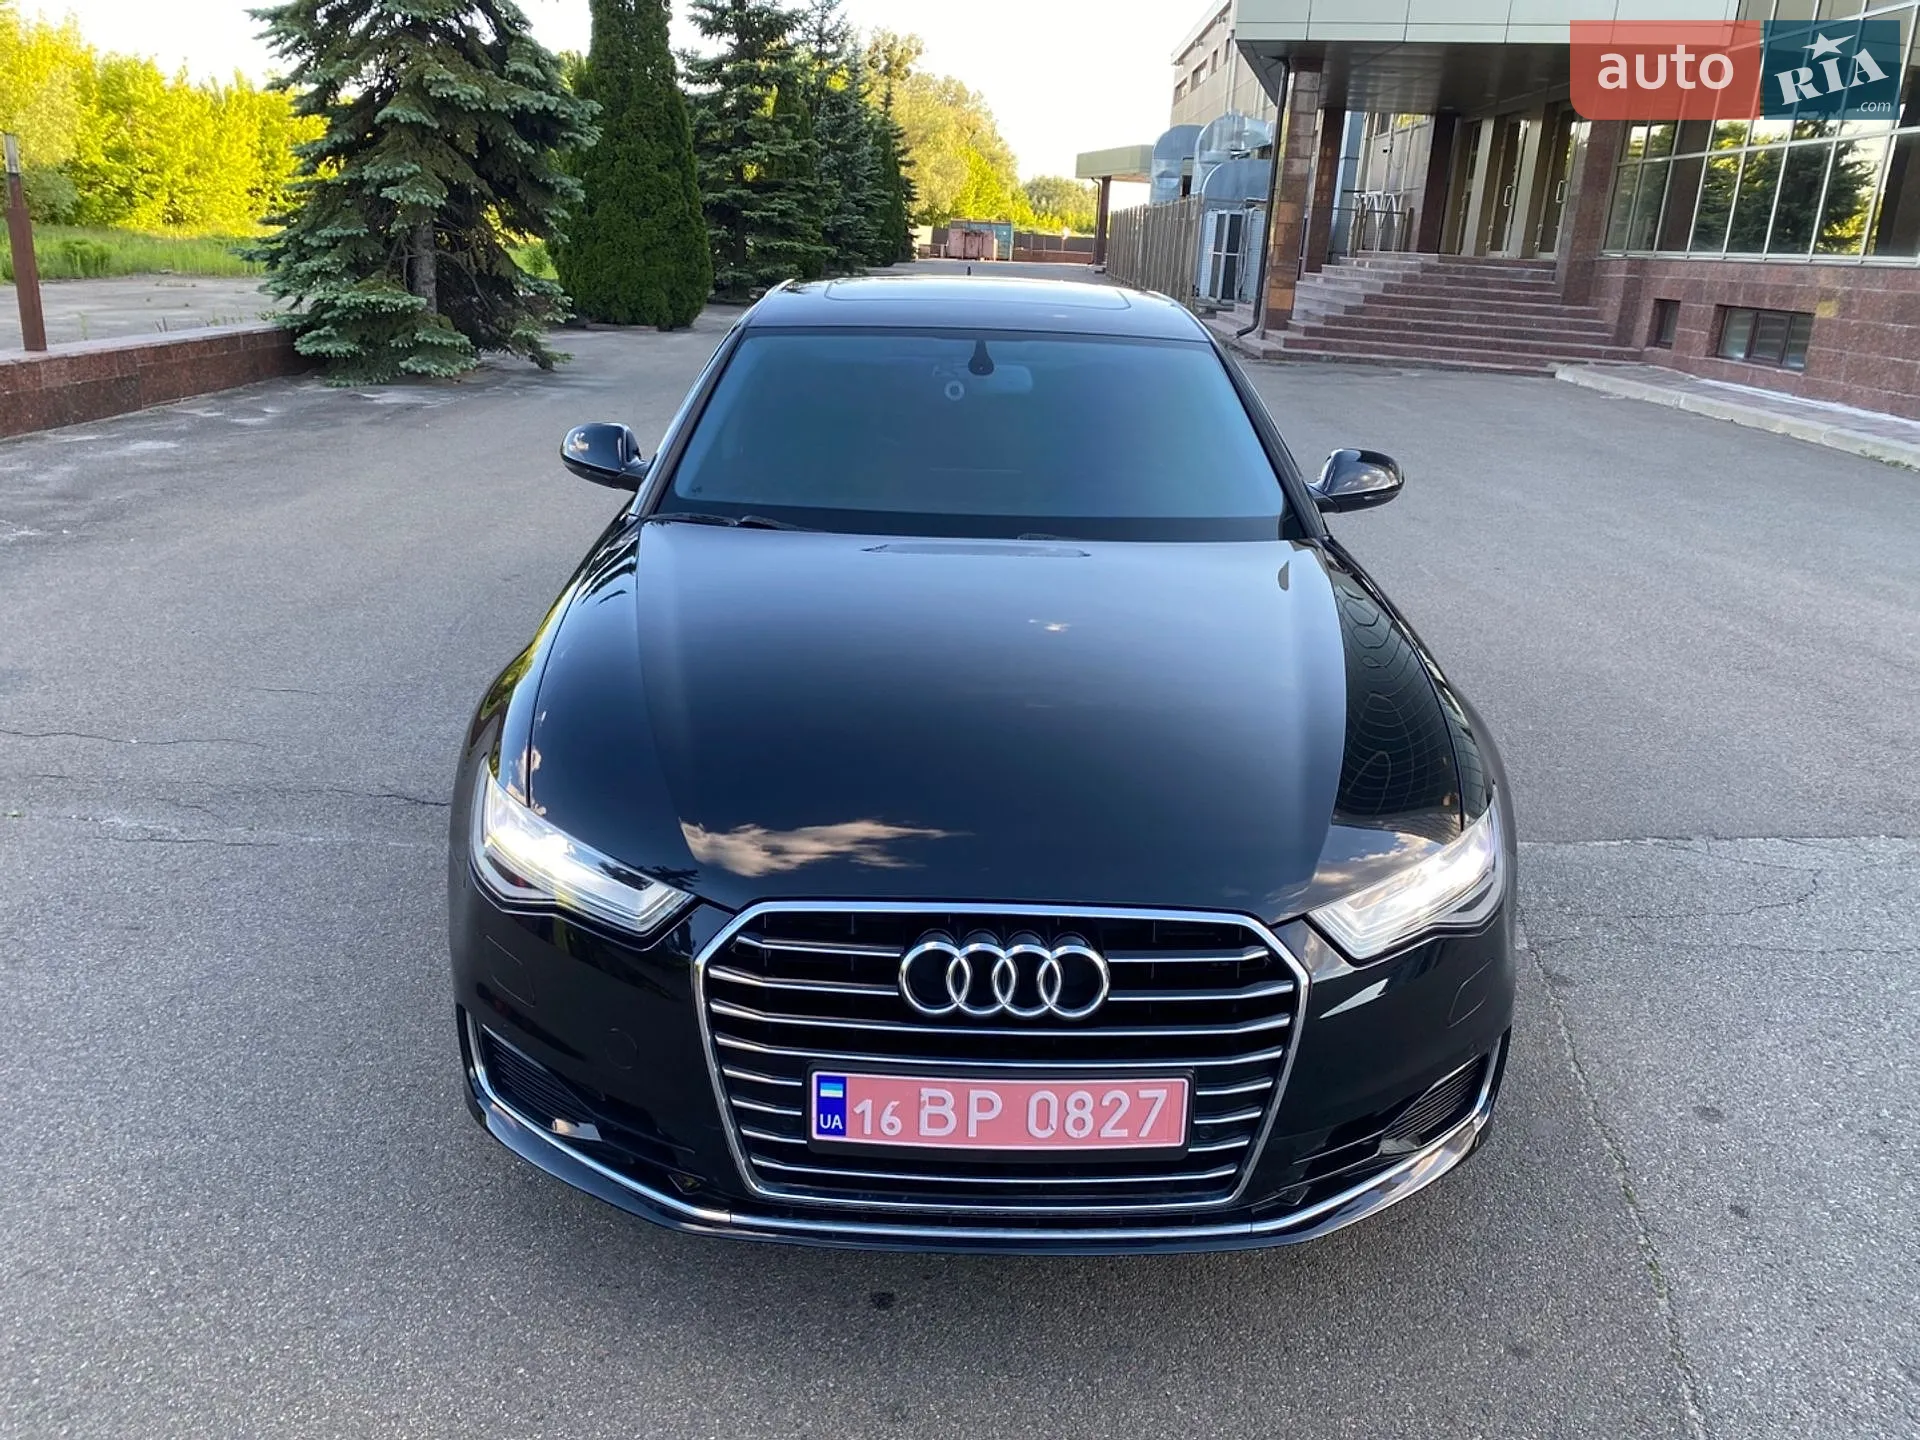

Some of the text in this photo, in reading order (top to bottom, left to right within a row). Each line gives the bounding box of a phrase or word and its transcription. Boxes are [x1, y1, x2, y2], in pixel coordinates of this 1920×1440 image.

[819, 1114, 843, 1130] UA
[853, 1087, 1168, 1139] 16 BP 0827
